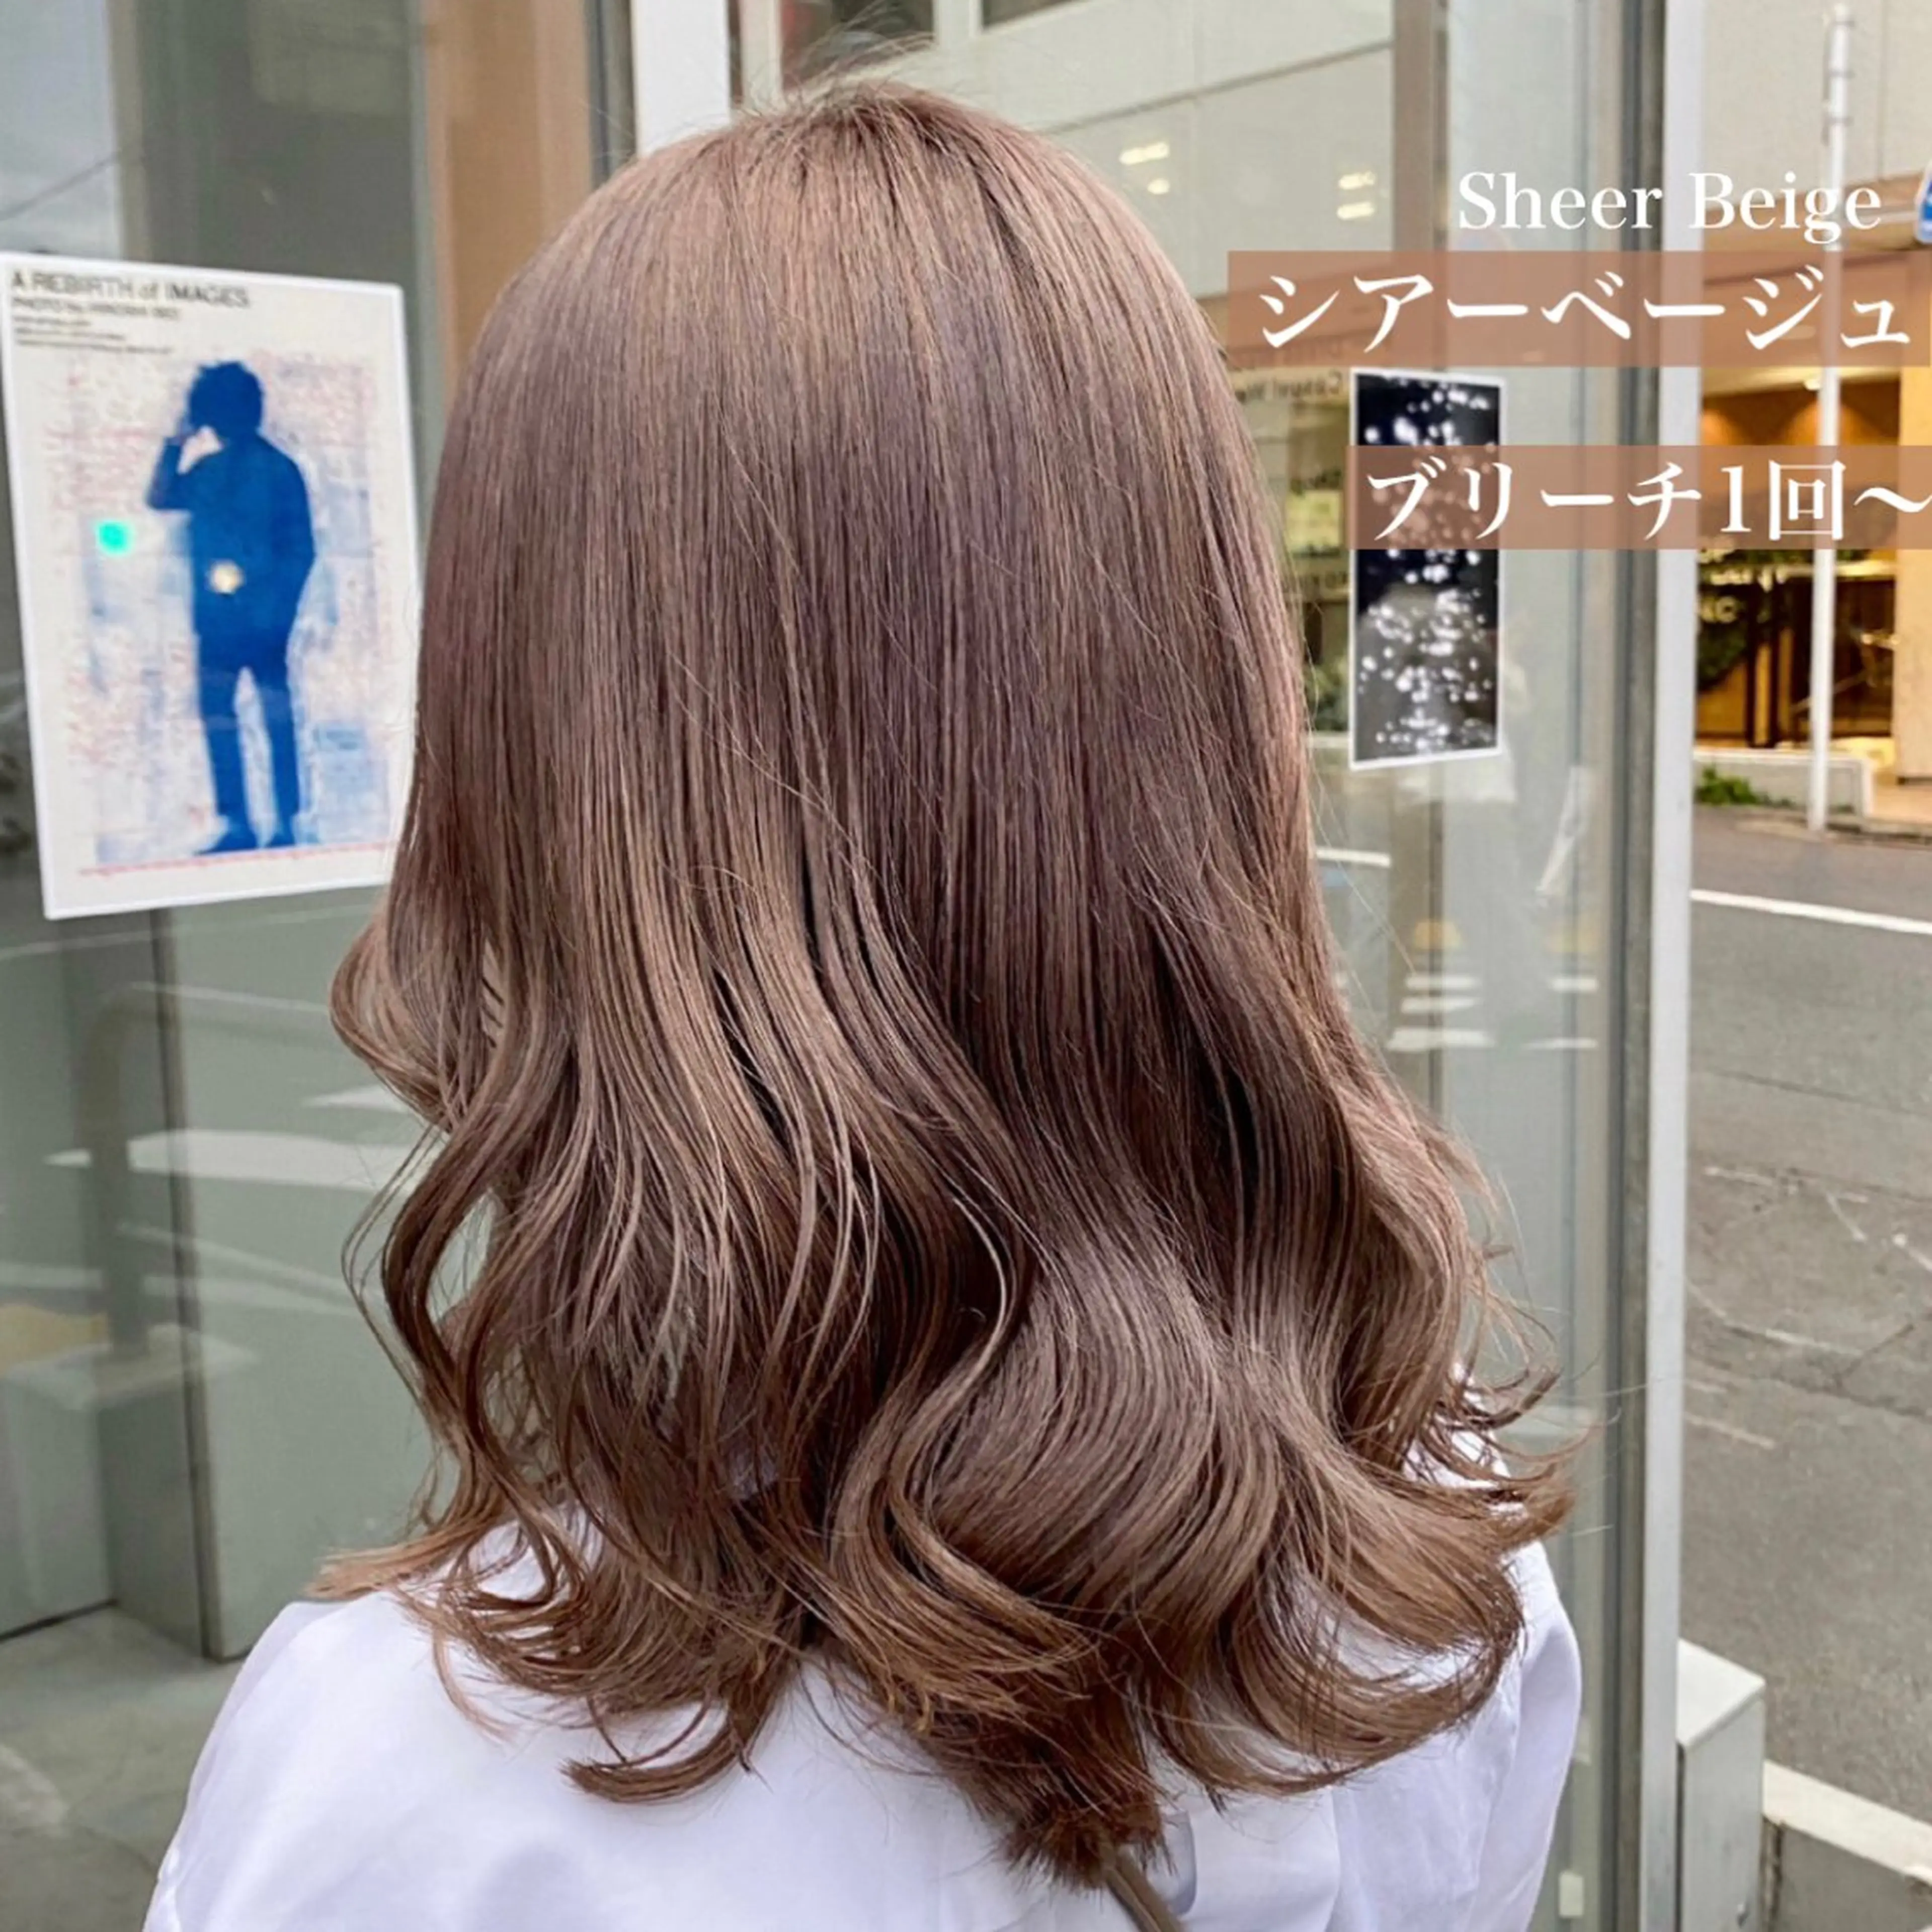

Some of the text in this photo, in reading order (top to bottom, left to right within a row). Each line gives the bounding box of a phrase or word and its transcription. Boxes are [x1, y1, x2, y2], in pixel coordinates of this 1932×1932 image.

[13, 271, 250, 309] A REBIRTH of IMAGES
